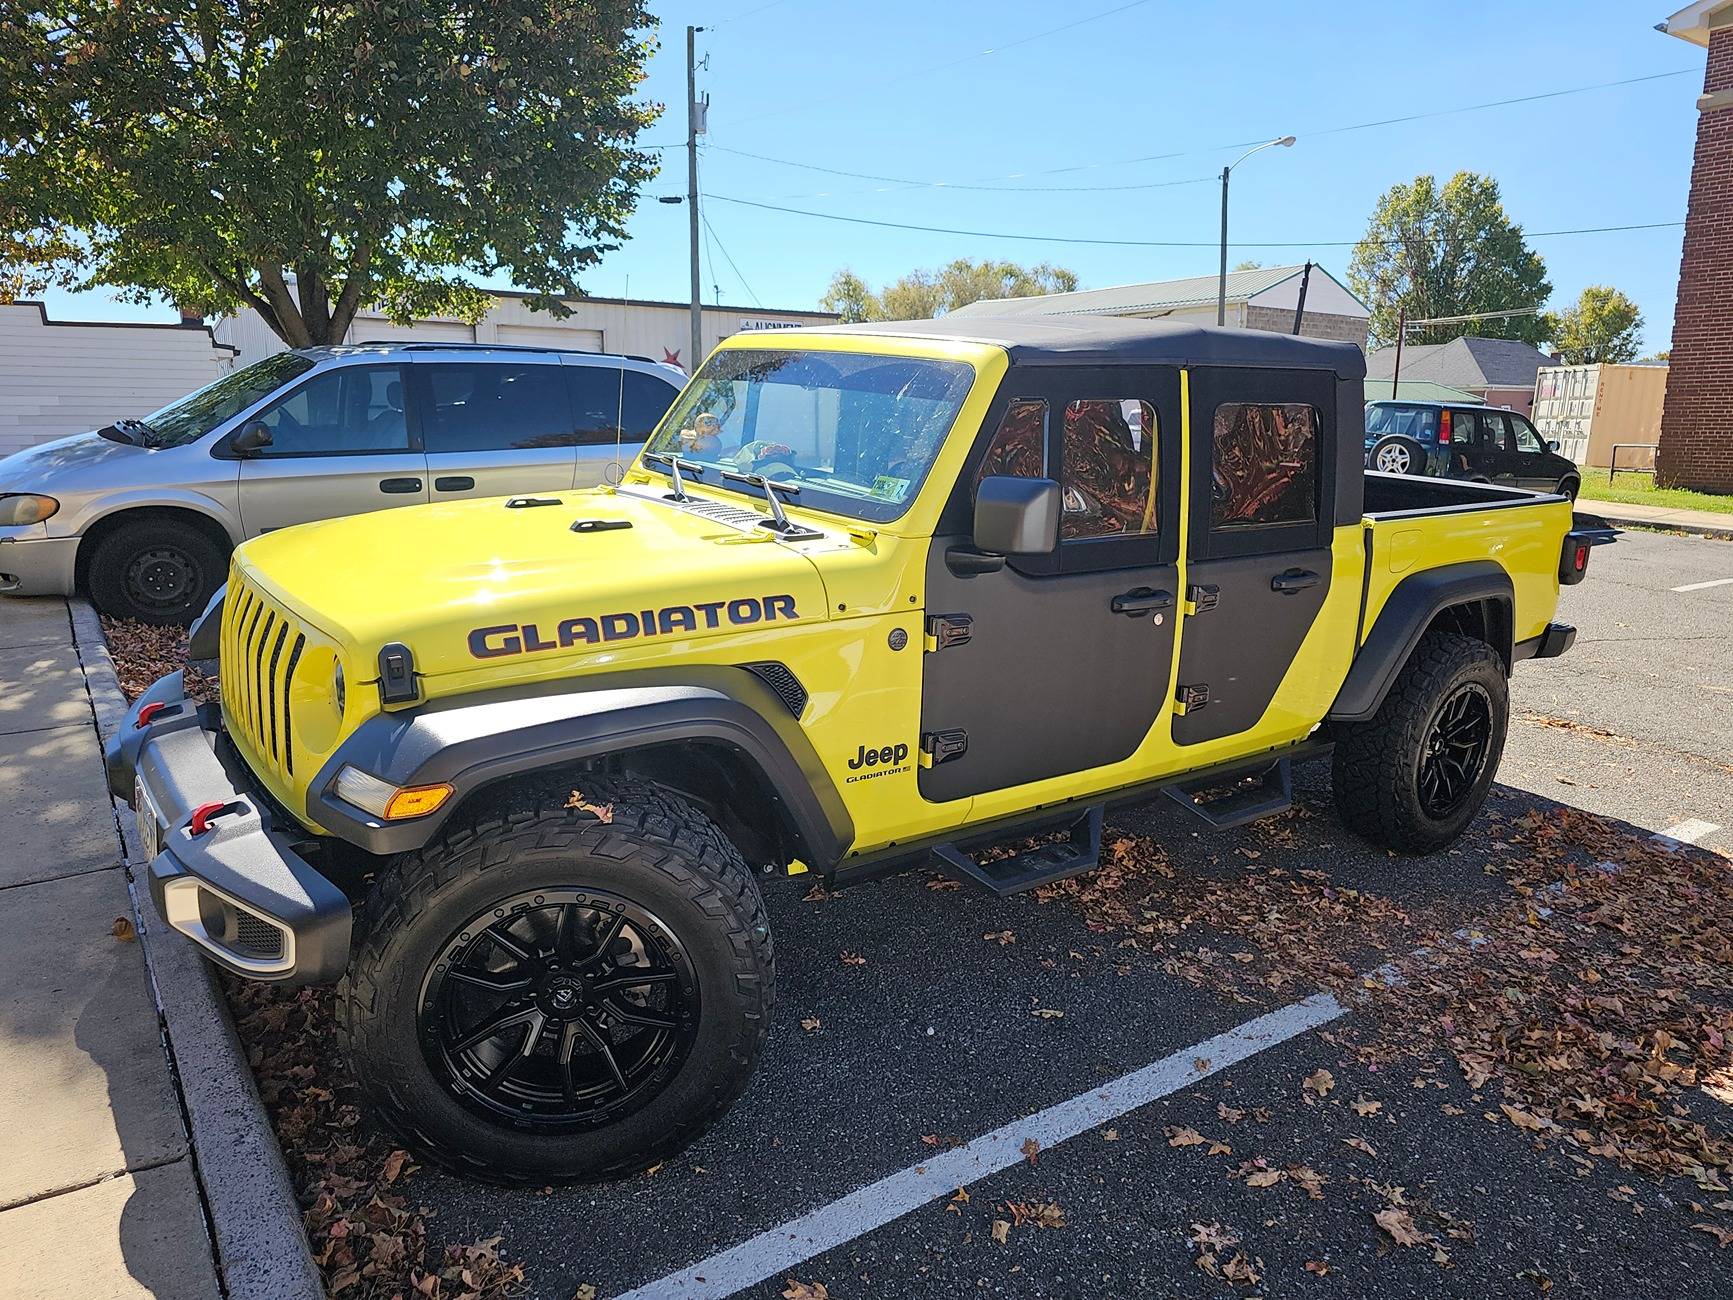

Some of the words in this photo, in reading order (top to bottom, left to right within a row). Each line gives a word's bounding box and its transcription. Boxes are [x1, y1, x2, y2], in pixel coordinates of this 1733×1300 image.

[755, 321, 802, 331] ALIGN
[467, 594, 800, 659] GLADIATOR
[848, 743, 909, 770] Jeep
[846, 768, 902, 783] GLADIATOR
